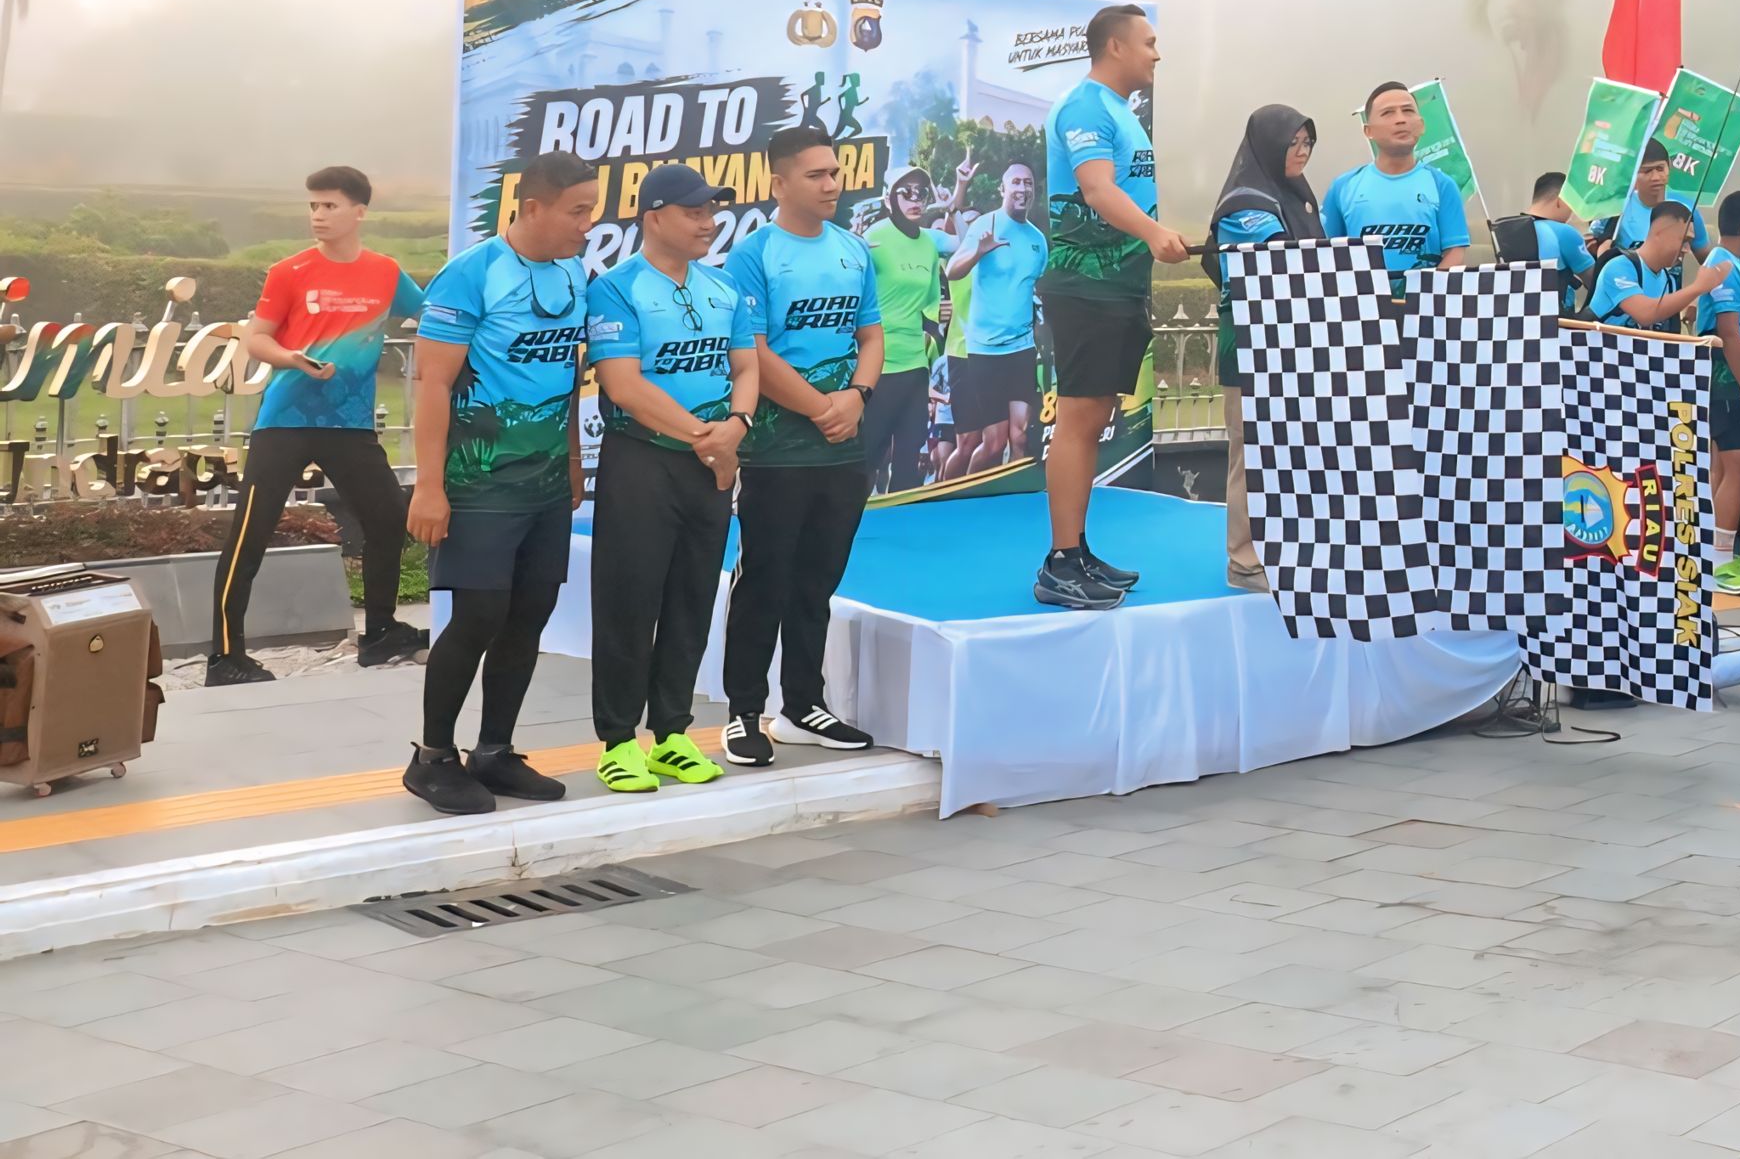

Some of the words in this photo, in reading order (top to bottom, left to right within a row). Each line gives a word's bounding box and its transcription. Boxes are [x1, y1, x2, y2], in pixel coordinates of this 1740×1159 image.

[1014, 27, 1065, 47] BERSAMA
[1008, 48, 1042, 64] UNTUK
[539, 92, 684, 161] ROAD
[698, 86, 758, 148] TO
[1360, 224, 1431, 238] ROAD
[787, 296, 860, 316] ROAD
[656, 337, 730, 358] ROAD
[1666, 401, 1697, 546] POLRES
[1641, 478, 1661, 563] RIAU
[1675, 555, 1702, 647] SIAK
